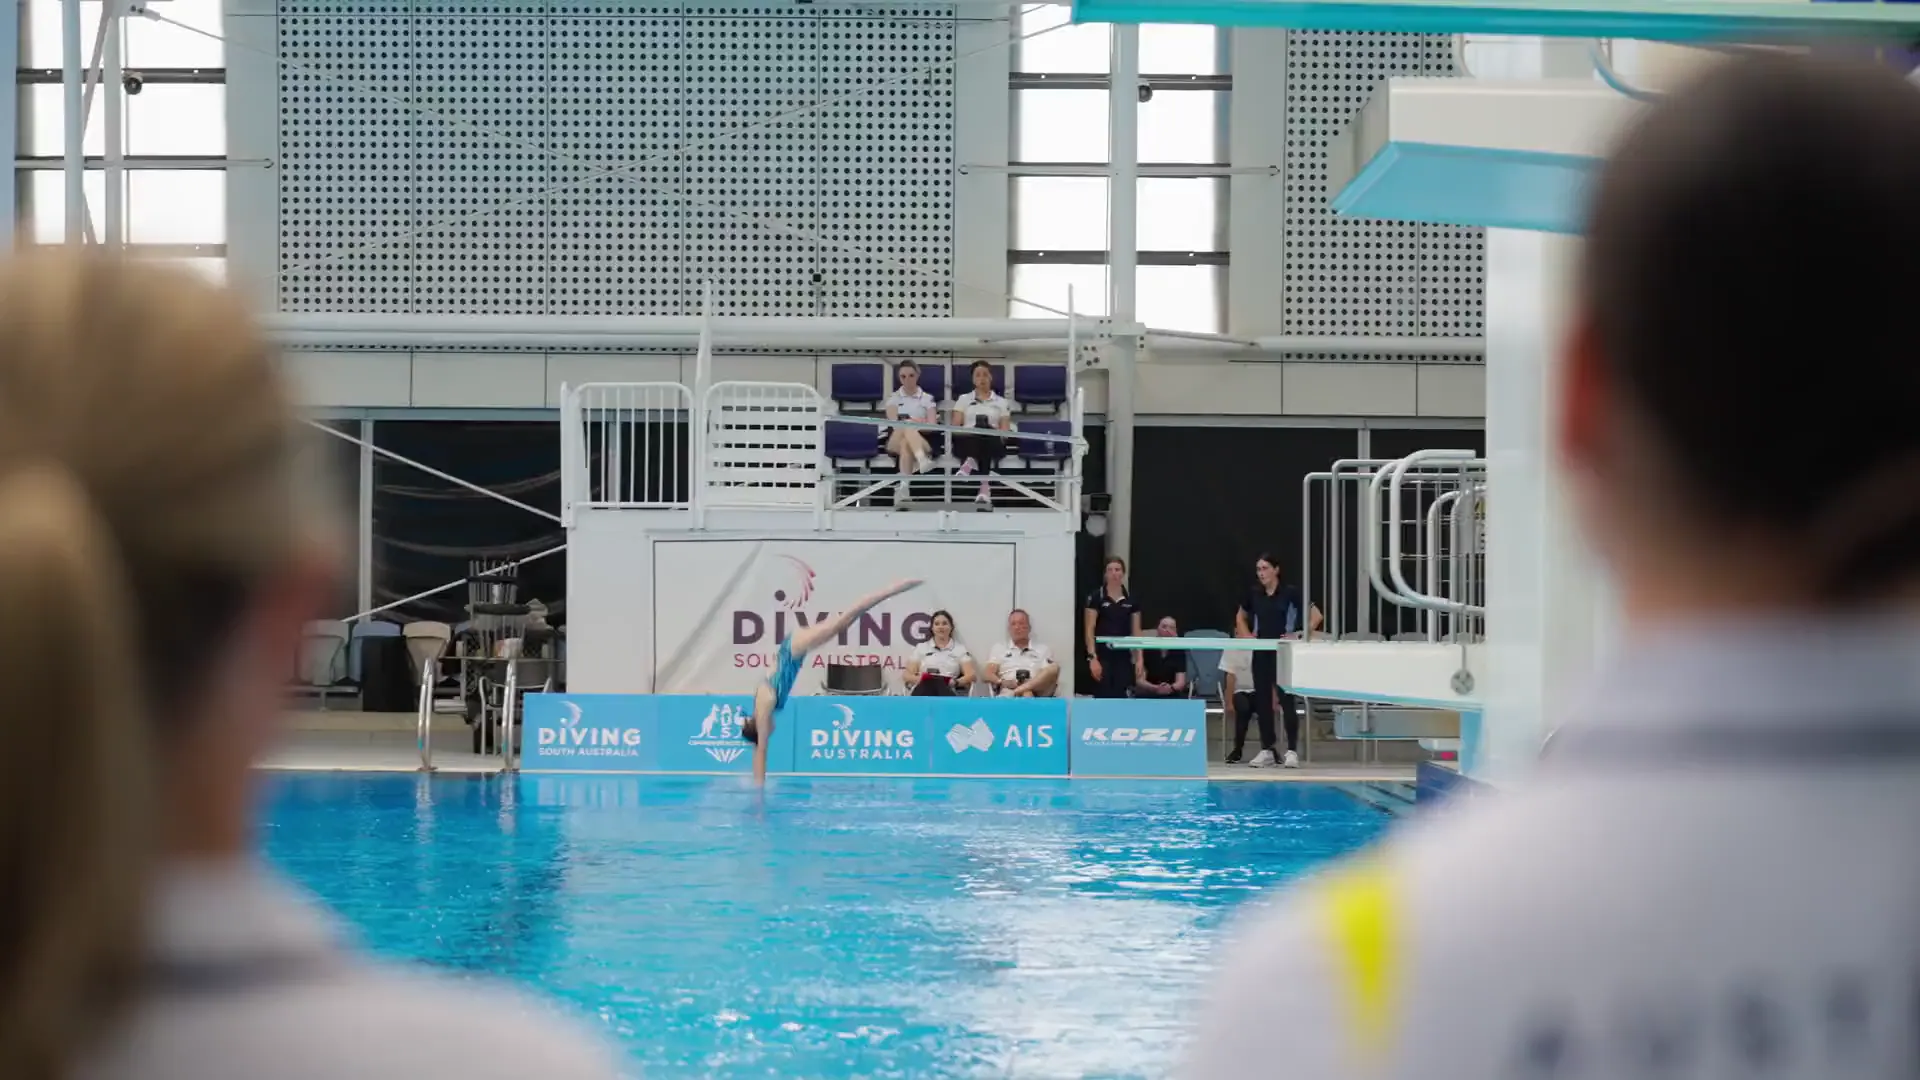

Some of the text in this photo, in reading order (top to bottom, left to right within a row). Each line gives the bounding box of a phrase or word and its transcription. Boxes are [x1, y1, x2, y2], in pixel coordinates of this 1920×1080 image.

[734, 653, 907, 670] SOU AUSTRAL
[539, 728, 641, 746] DIVING
[811, 729, 914, 747] DIVING
[1003, 724, 1054, 748] AIS
[1082, 727, 1197, 742] KOZII
[539, 747, 639, 757] SOUTH AUSTRALIA
[811, 748, 913, 760] AUSTRALIA
